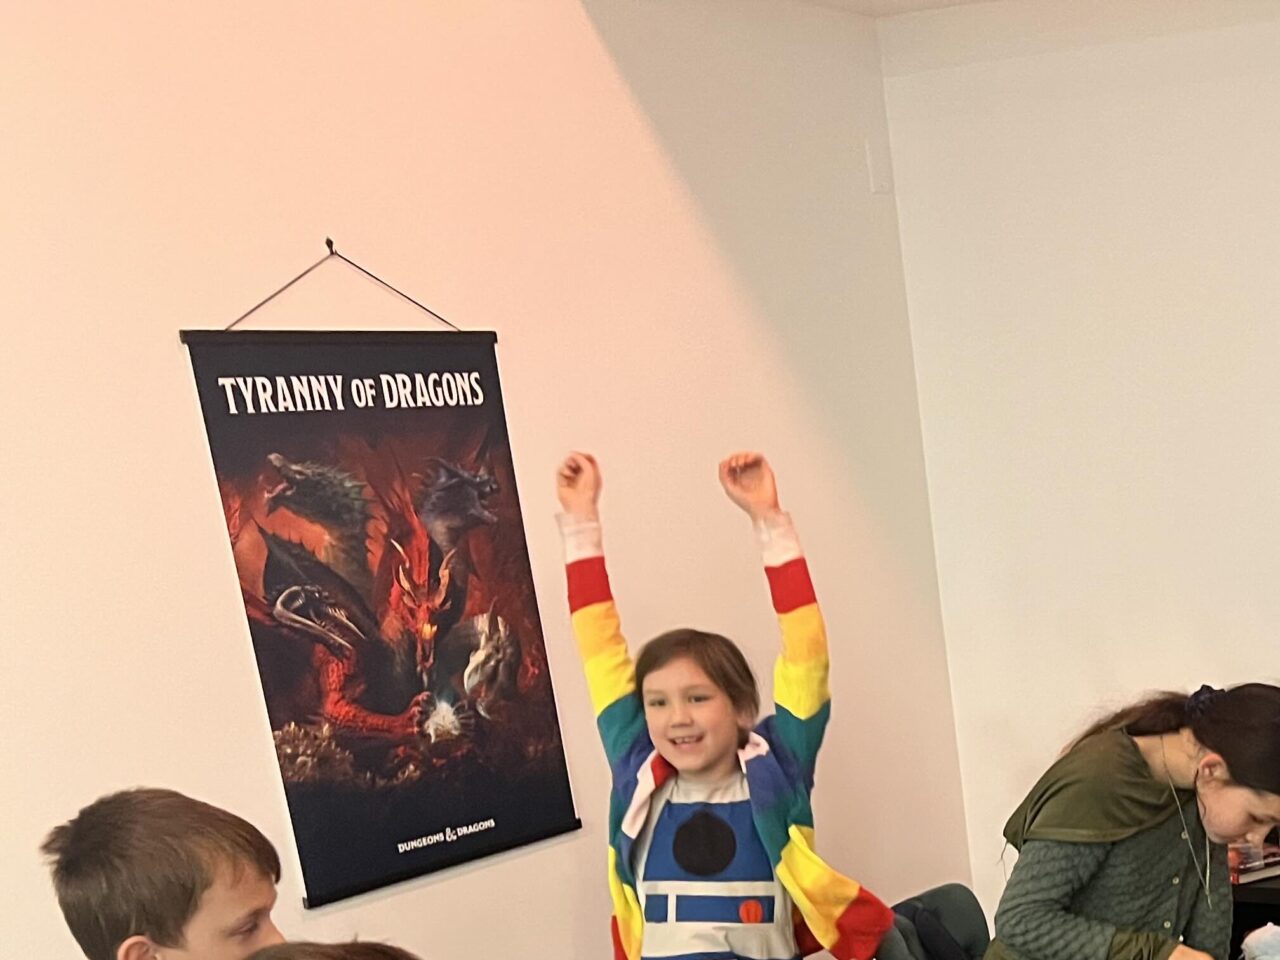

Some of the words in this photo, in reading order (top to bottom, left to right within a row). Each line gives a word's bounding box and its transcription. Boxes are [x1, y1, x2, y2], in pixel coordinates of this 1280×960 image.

[217, 375, 345, 414] TYRANNY
[350, 378, 376, 408] OF
[379, 371, 484, 409] DRAGONS
[397, 832, 445, 854] DUNGEONS
[445, 827, 457, 842] &
[456, 818, 496, 837] DRAGONS
